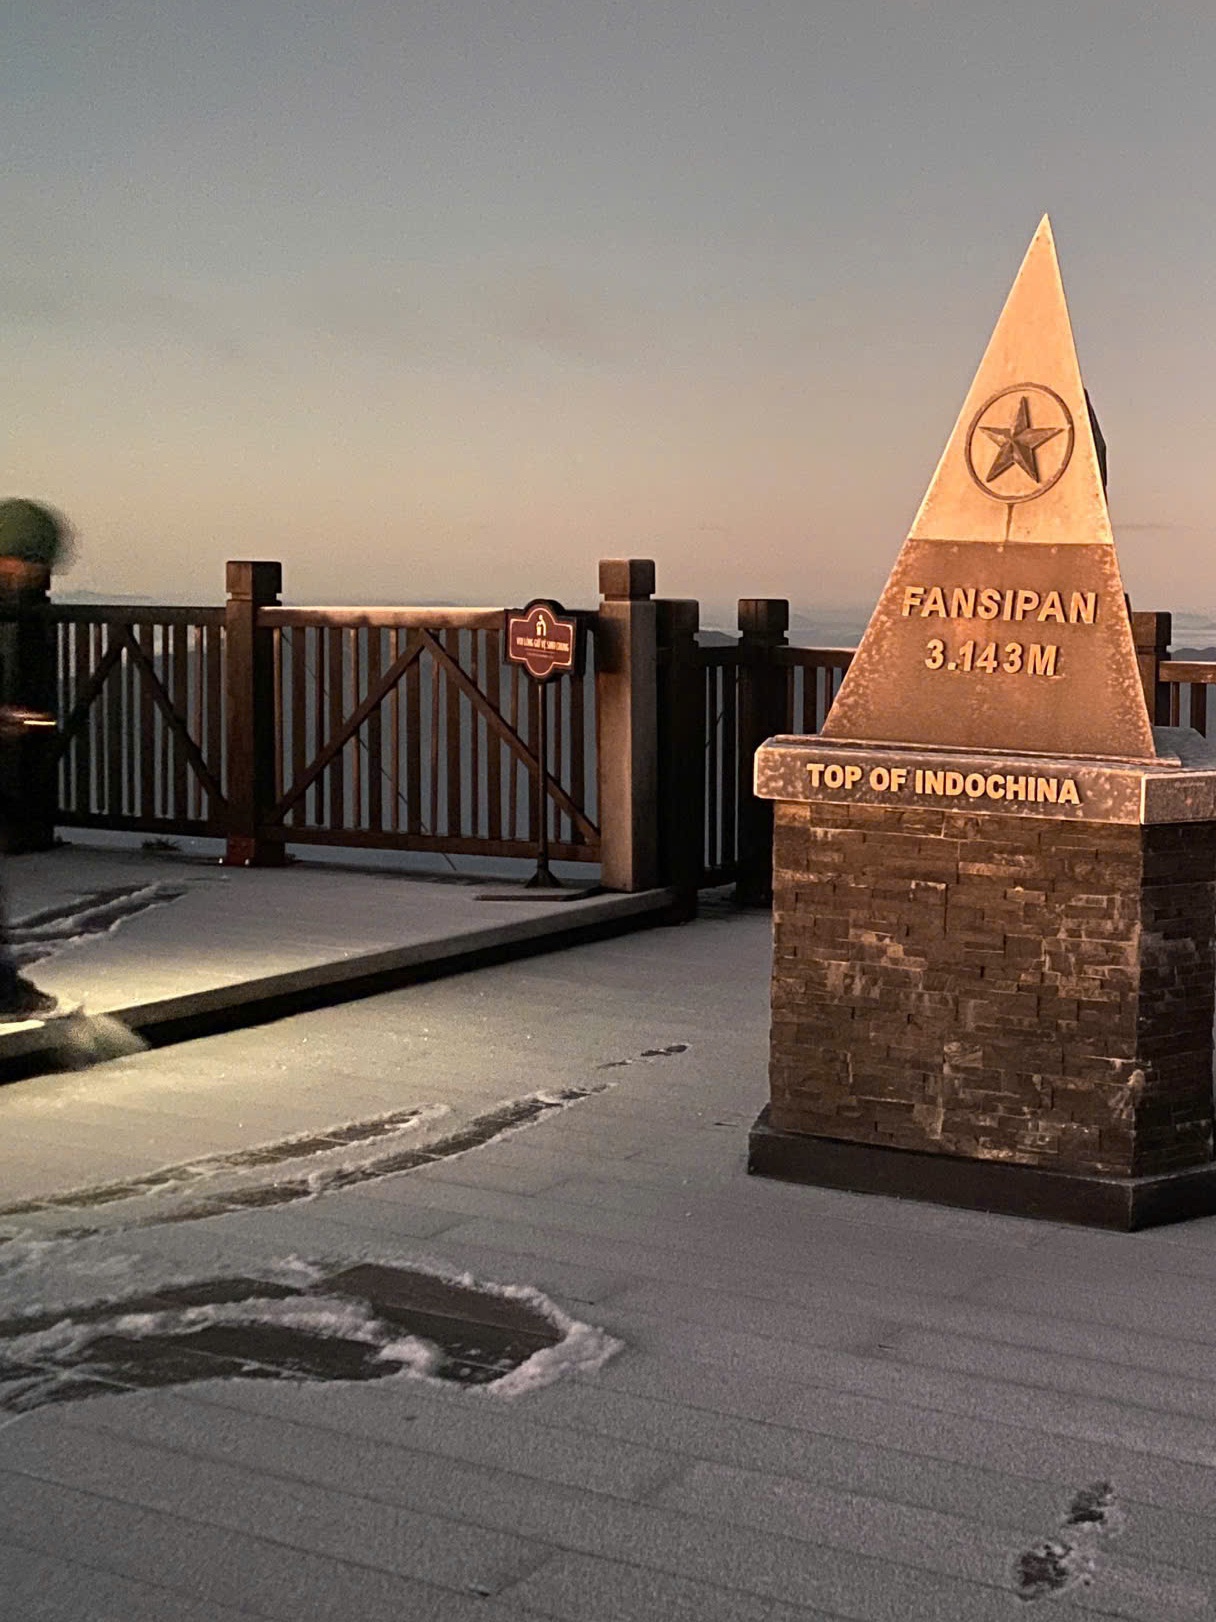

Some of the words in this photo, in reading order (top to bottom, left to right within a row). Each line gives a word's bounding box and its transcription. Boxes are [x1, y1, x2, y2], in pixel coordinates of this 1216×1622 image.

[901, 586, 1097, 624] FANSIPAN
[925, 639, 1059, 677] 3.143M
[807, 764, 862, 788] TOP
[869, 766, 907, 791] OF
[916, 769, 1079, 804] INDOCHINA
